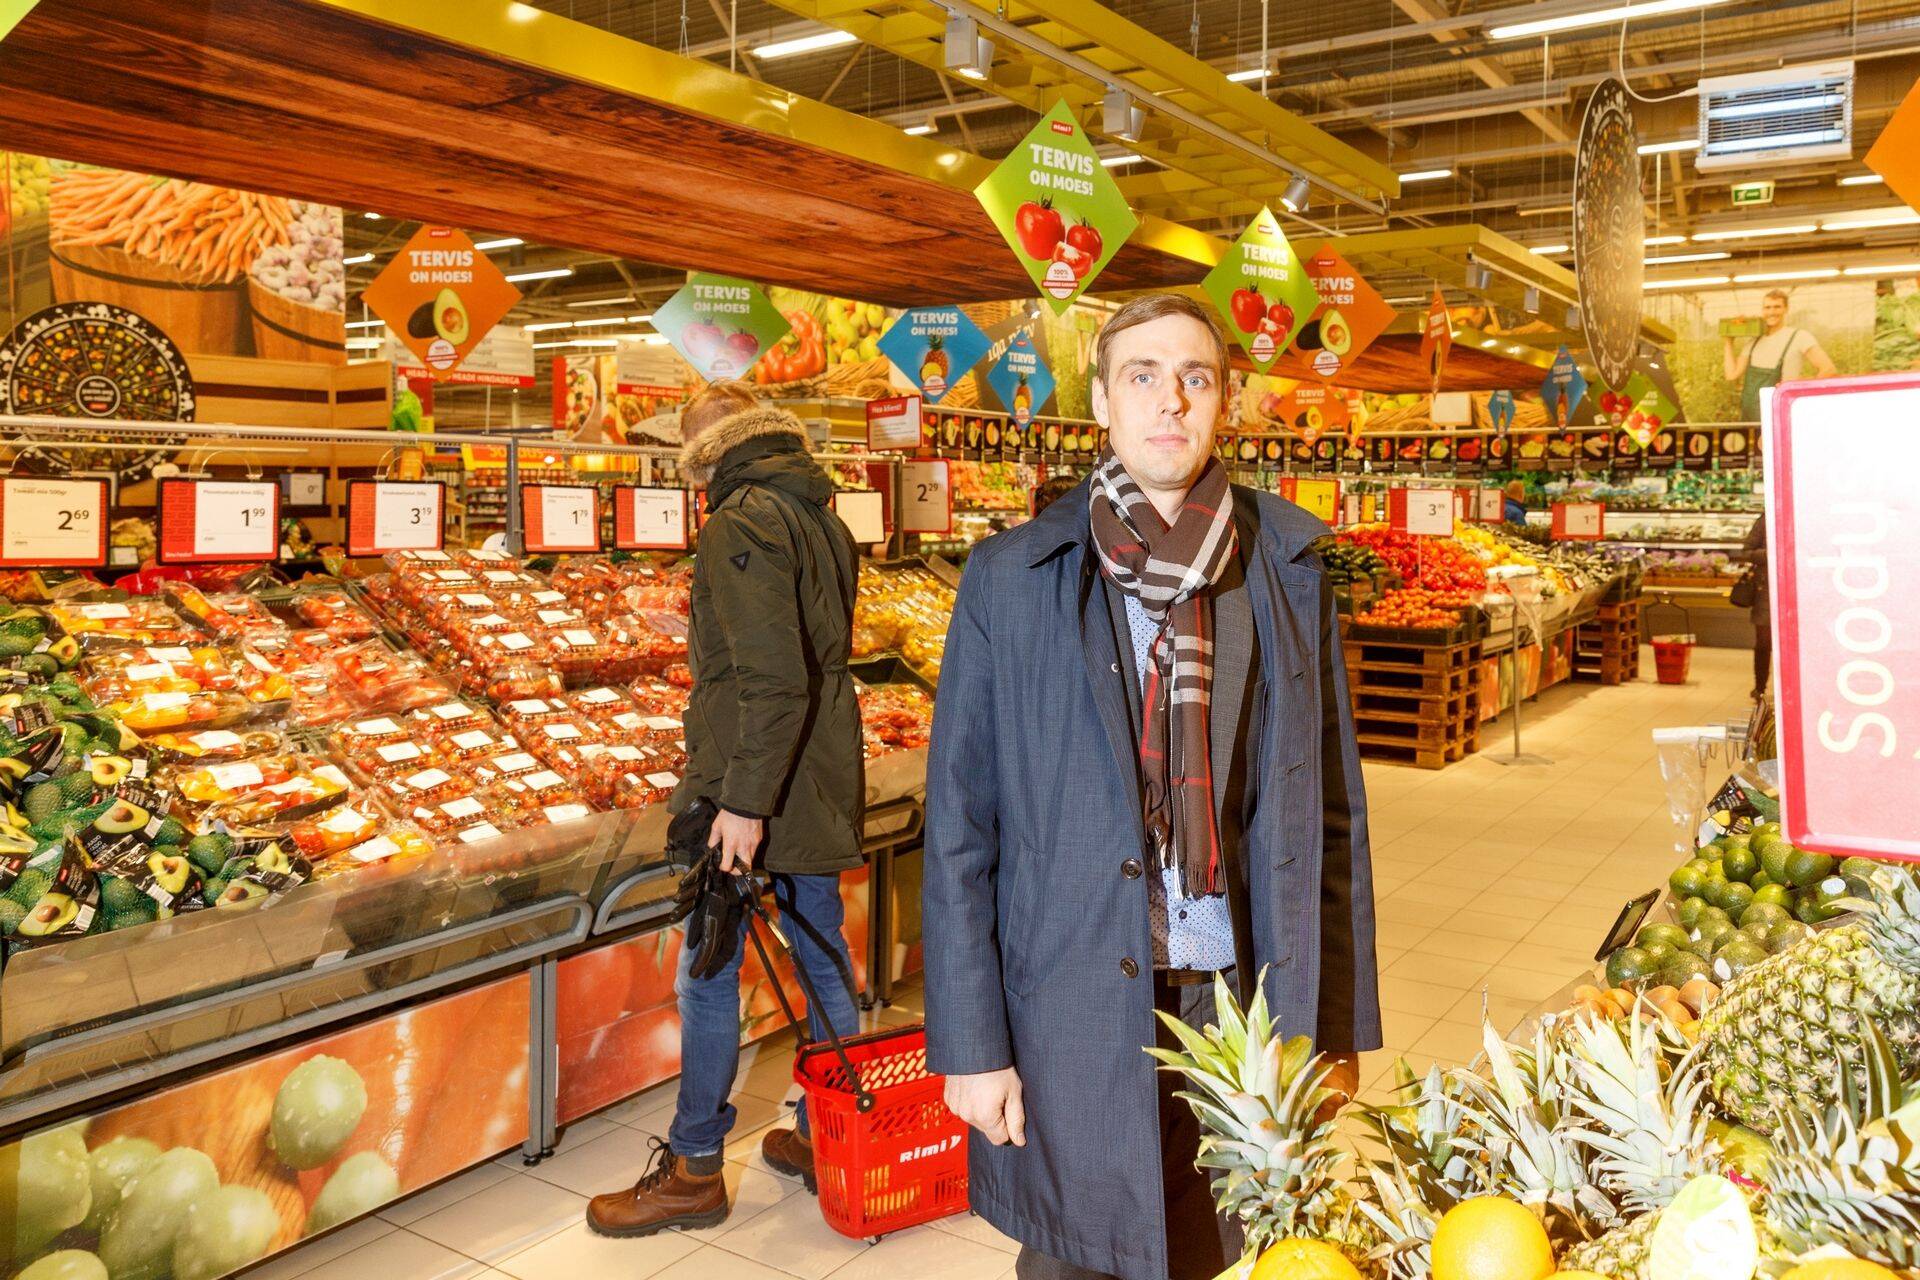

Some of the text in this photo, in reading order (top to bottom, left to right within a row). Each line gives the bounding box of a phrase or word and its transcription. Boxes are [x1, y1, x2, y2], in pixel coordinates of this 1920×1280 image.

[1030, 143, 1094, 176] TERVIS
[1030, 170, 1093, 196] ON MOES!
[409, 250, 474, 267] TERVIS
[1242, 243, 1289, 267] TERVIS
[409, 271, 473, 284] ON MOES!
[1242, 264, 1289, 282] ON MOES!
[693, 284, 751, 300] TERVIS
[1311, 276, 1355, 292] ERVIS
[693, 302, 750, 314] ON MOES!
[911, 312, 959, 325] TERVIS
[911, 327, 926, 337] ON
[1008, 352, 1037, 365] TERVIS
